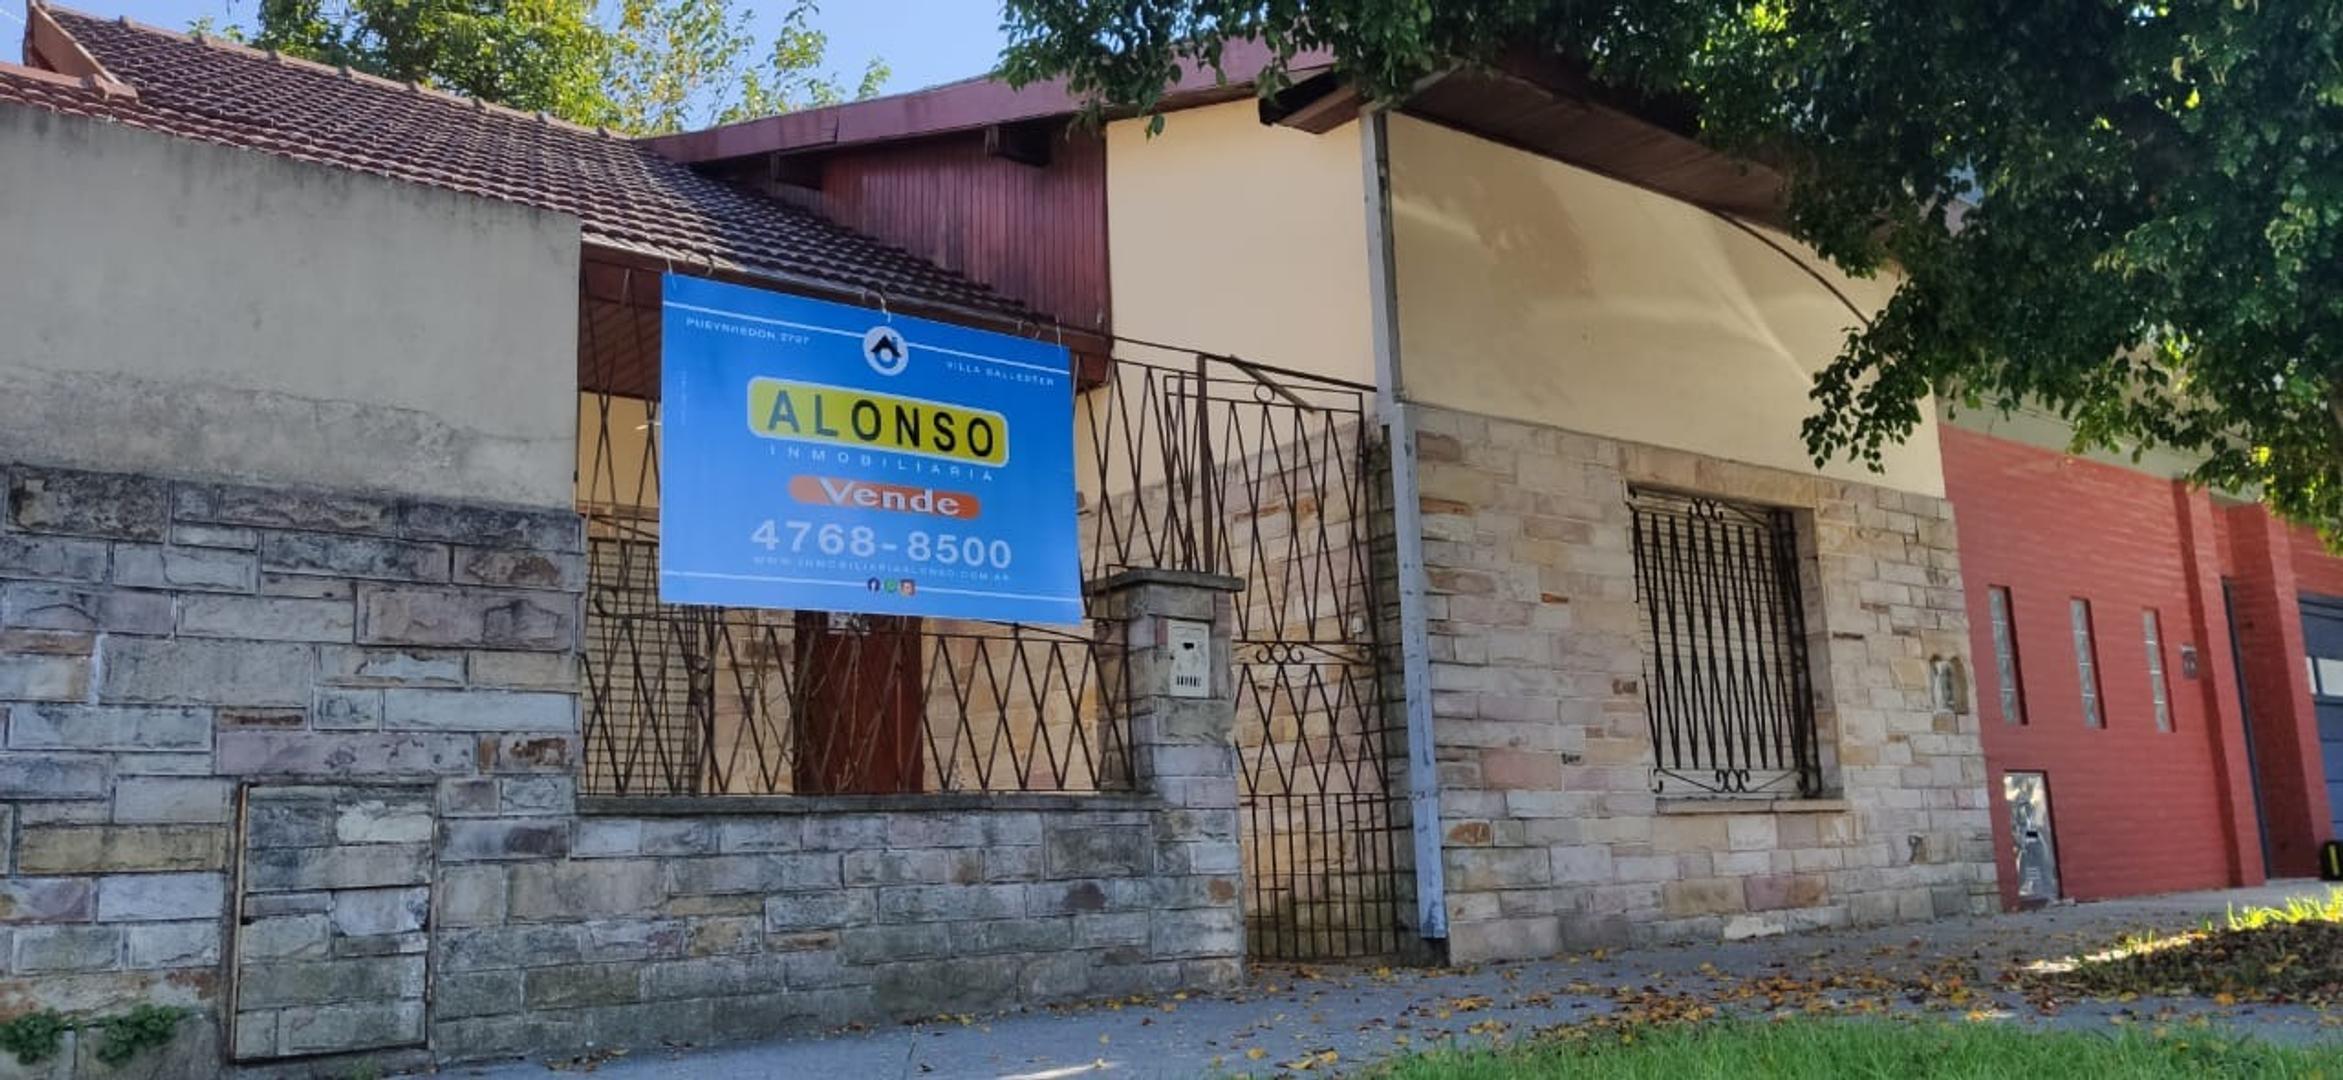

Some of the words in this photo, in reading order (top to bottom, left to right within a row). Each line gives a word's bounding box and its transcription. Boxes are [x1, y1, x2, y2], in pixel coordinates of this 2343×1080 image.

[768, 389, 994, 457] ALONSO
[769, 446, 993, 481] INMOBILIARIA
[818, 477, 960, 516] Vende
[751, 520, 1012, 569] 4768-8500
